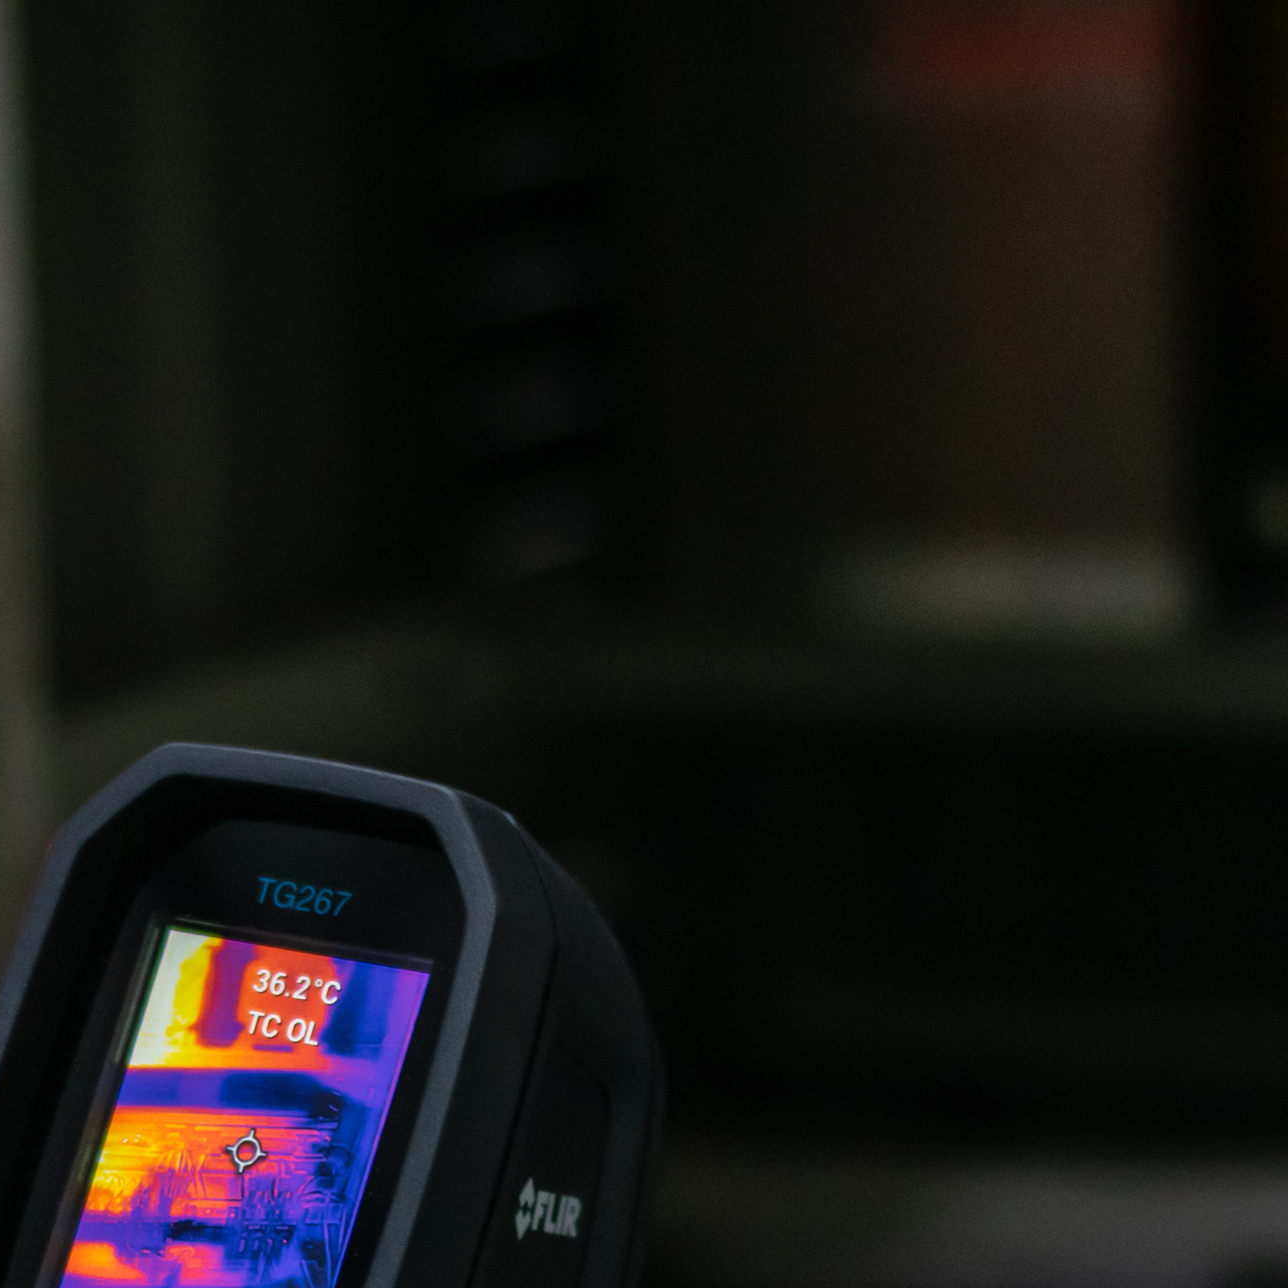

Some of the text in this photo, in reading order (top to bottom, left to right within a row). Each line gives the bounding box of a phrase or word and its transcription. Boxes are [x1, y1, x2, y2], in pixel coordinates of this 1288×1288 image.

[258, 876, 353, 917] TG267
[252, 969, 341, 1005] 36.2°C
[248, 1010, 319, 1047] TC OL
[530, 1189, 581, 1238] FLIR
